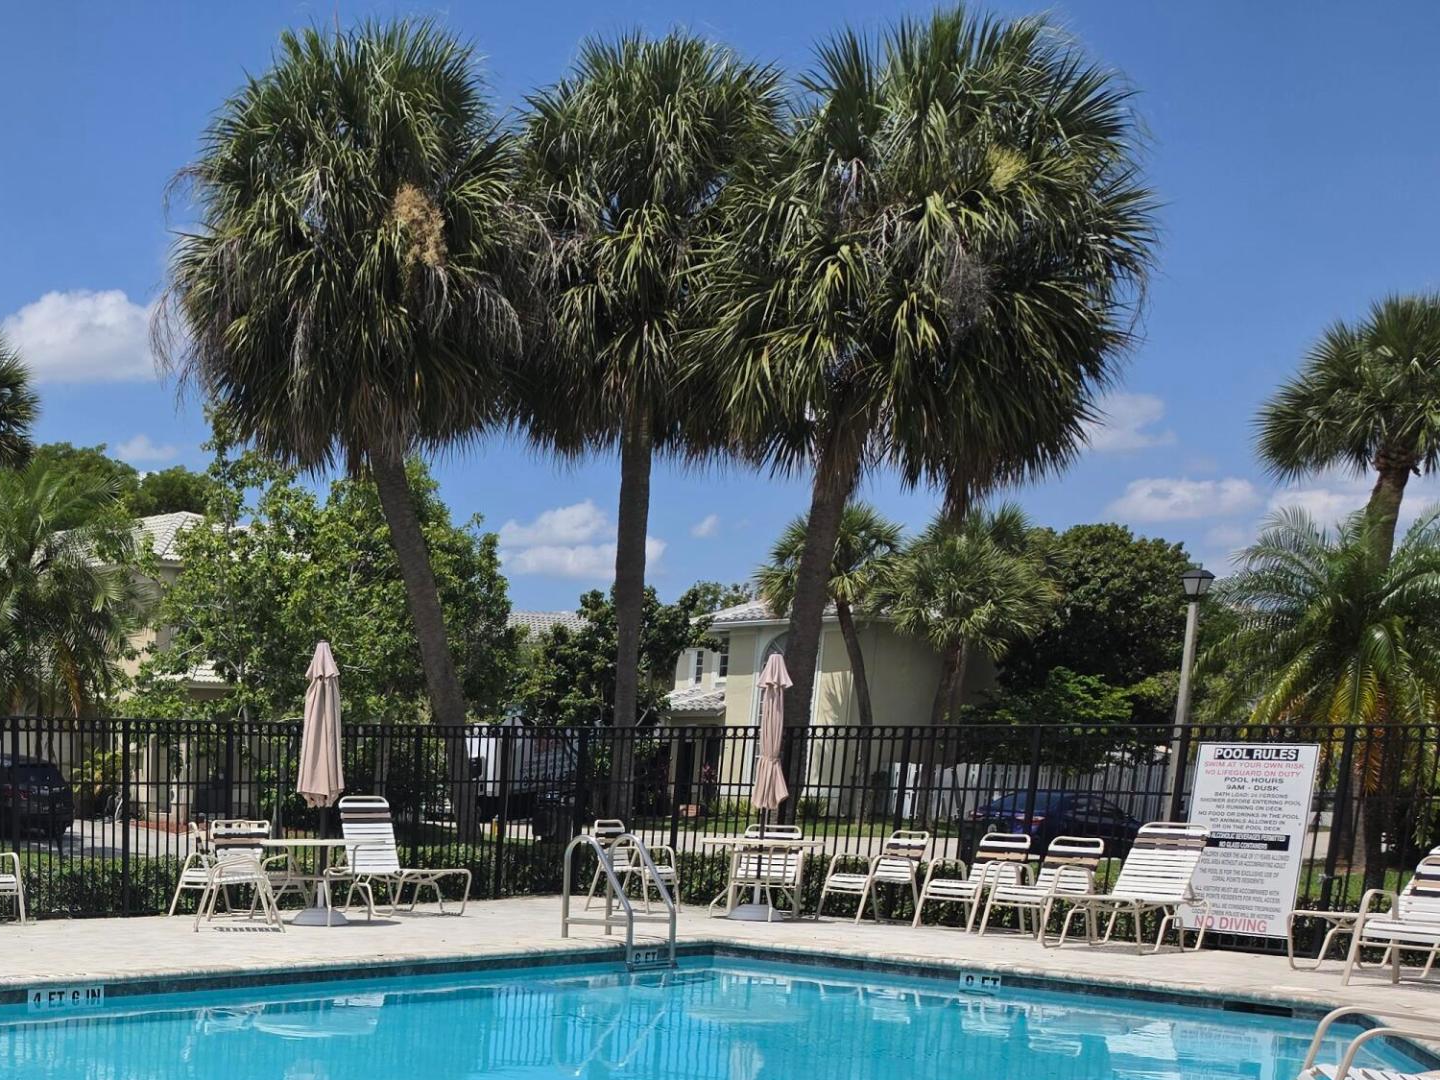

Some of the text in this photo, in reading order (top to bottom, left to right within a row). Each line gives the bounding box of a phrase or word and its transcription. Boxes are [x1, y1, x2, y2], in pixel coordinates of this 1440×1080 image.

[1215, 748, 1297, 761] POOL RULES
[1194, 915, 1268, 933] NO DIVING
